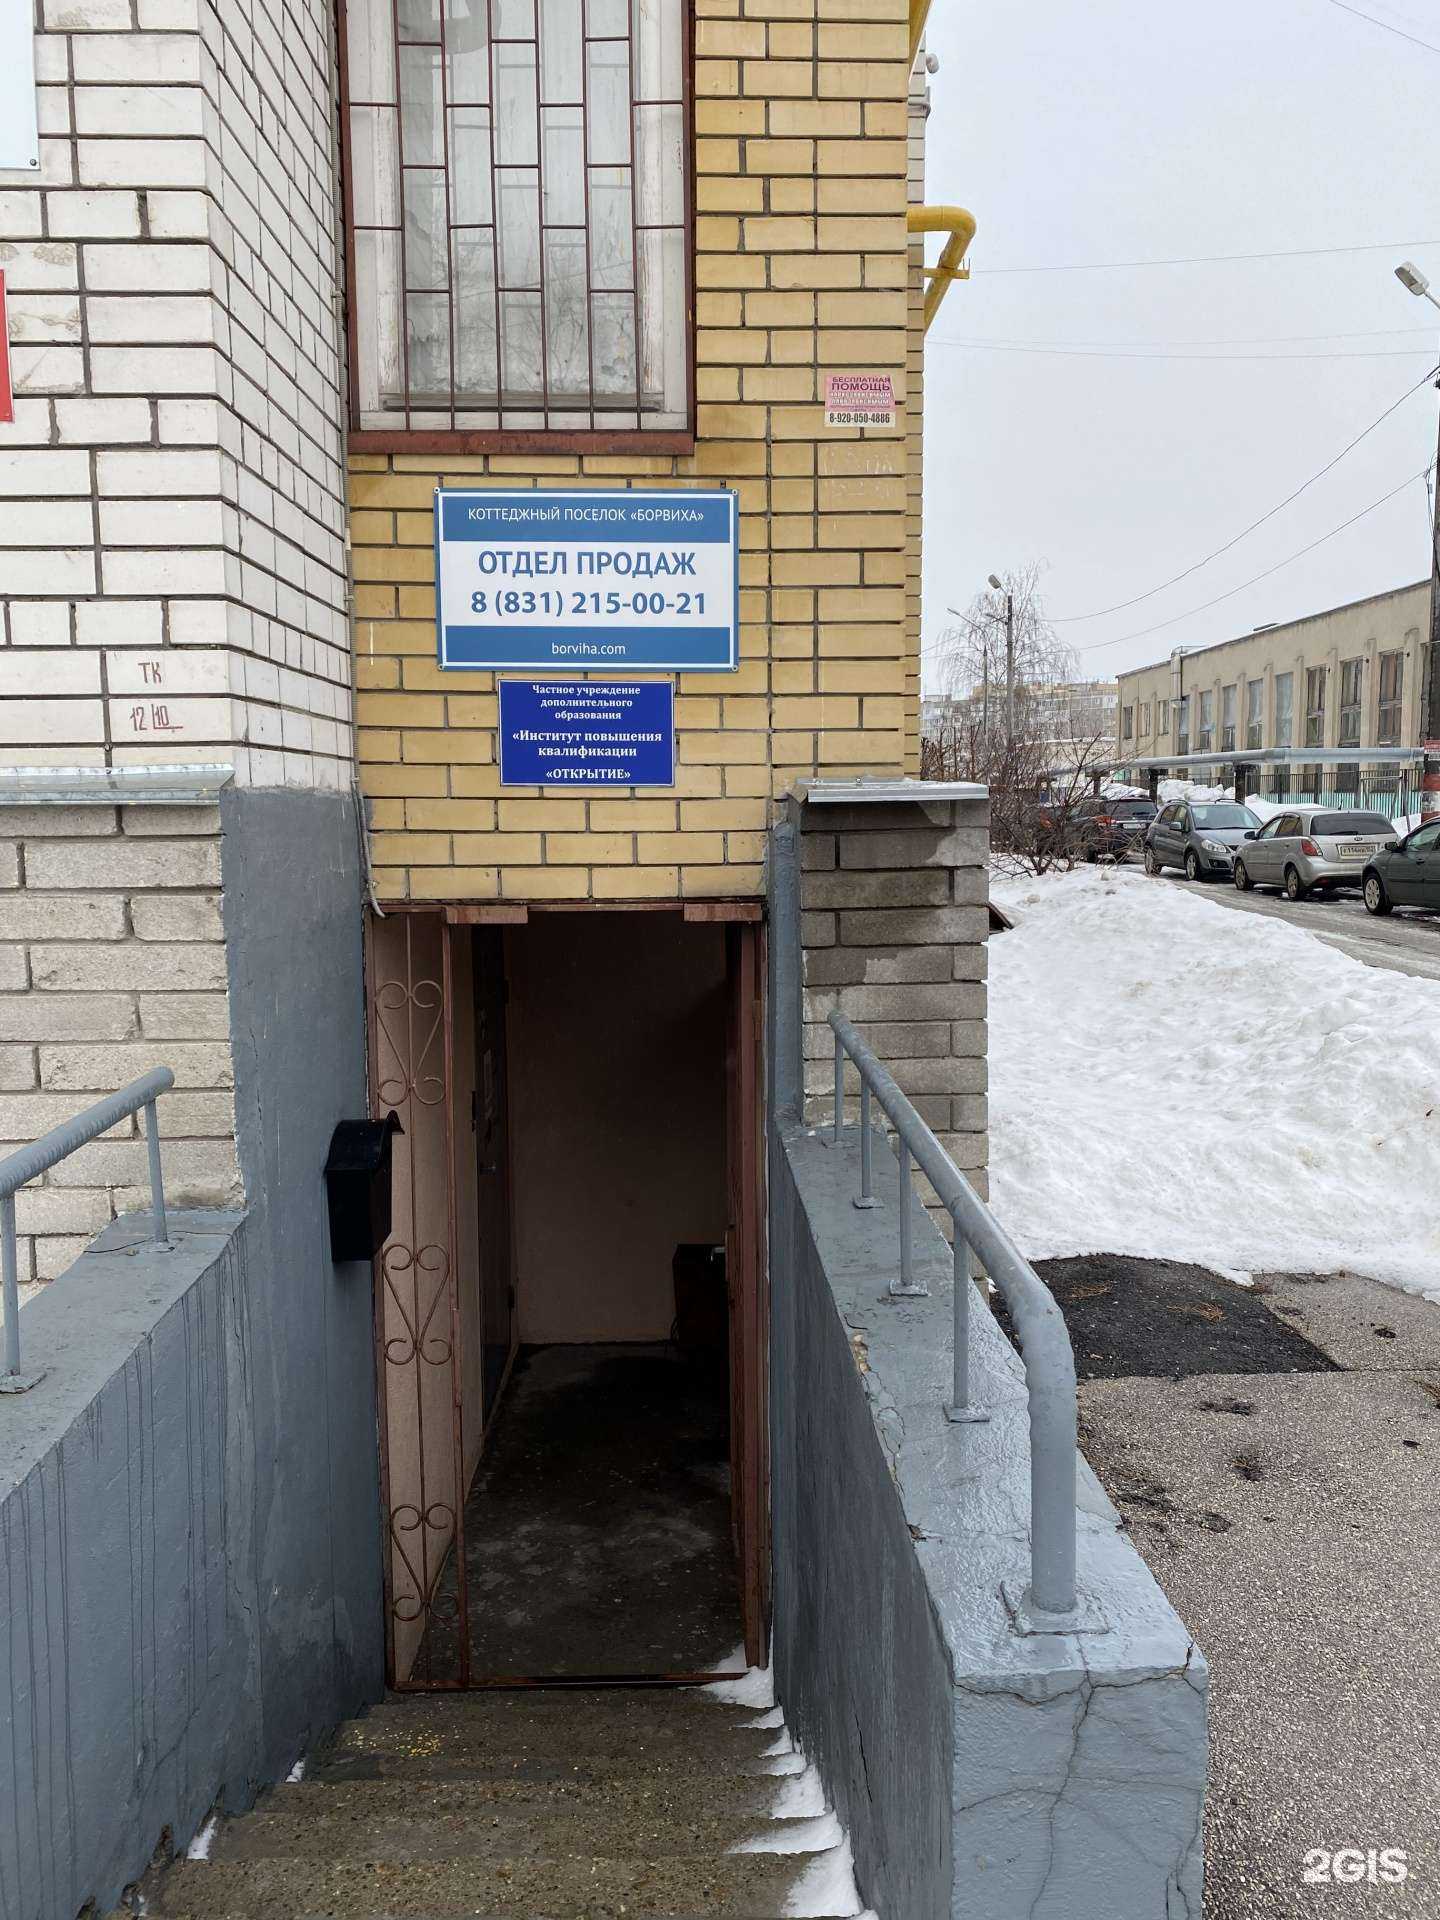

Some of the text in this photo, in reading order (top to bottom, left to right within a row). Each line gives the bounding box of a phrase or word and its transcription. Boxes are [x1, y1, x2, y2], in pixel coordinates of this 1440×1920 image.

[831, 383, 890, 391] ПОМОЩЬ
[468, 506, 704, 522] КОТТЕДЖНЫЙ ПОСЕЛОК «БОРВИХА»
[478, 550, 697, 579] ОТДЕЛ ПРОДАЖ
[471, 590, 705, 617] 8 (831) 215-00-21
[551, 642, 626, 655] borviha.com
[532, 684, 641, 696] Частное учреждение
[540, 699, 633, 708] дополнительного
[555, 711, 622, 721] образования
[512, 730, 662, 744] «Институт повышения
[538, 746, 637, 758] квалификации
[546, 768, 631, 779] «ОТКРЫТИЕ»
